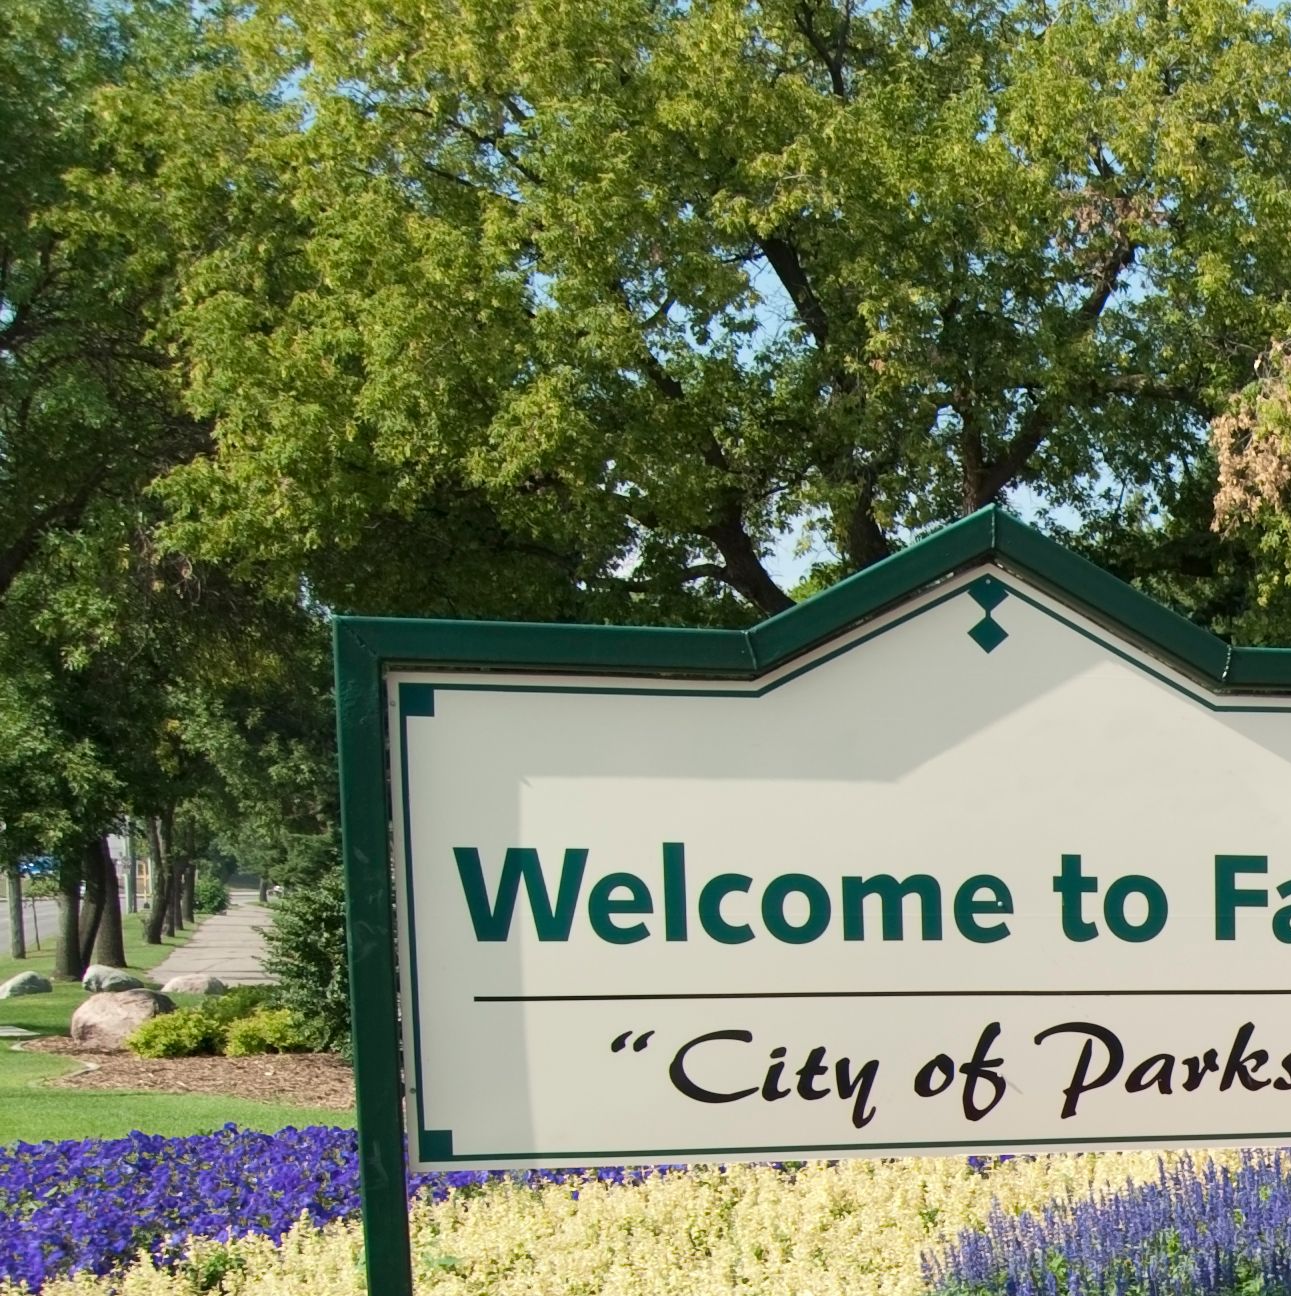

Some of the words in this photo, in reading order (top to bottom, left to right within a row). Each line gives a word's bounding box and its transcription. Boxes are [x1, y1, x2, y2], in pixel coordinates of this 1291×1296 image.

[452, 841, 1014, 945] Welcome
[1053, 853, 1169, 943] to
[610, 1021, 878, 1129] “City
[913, 1021, 1007, 1122] of
